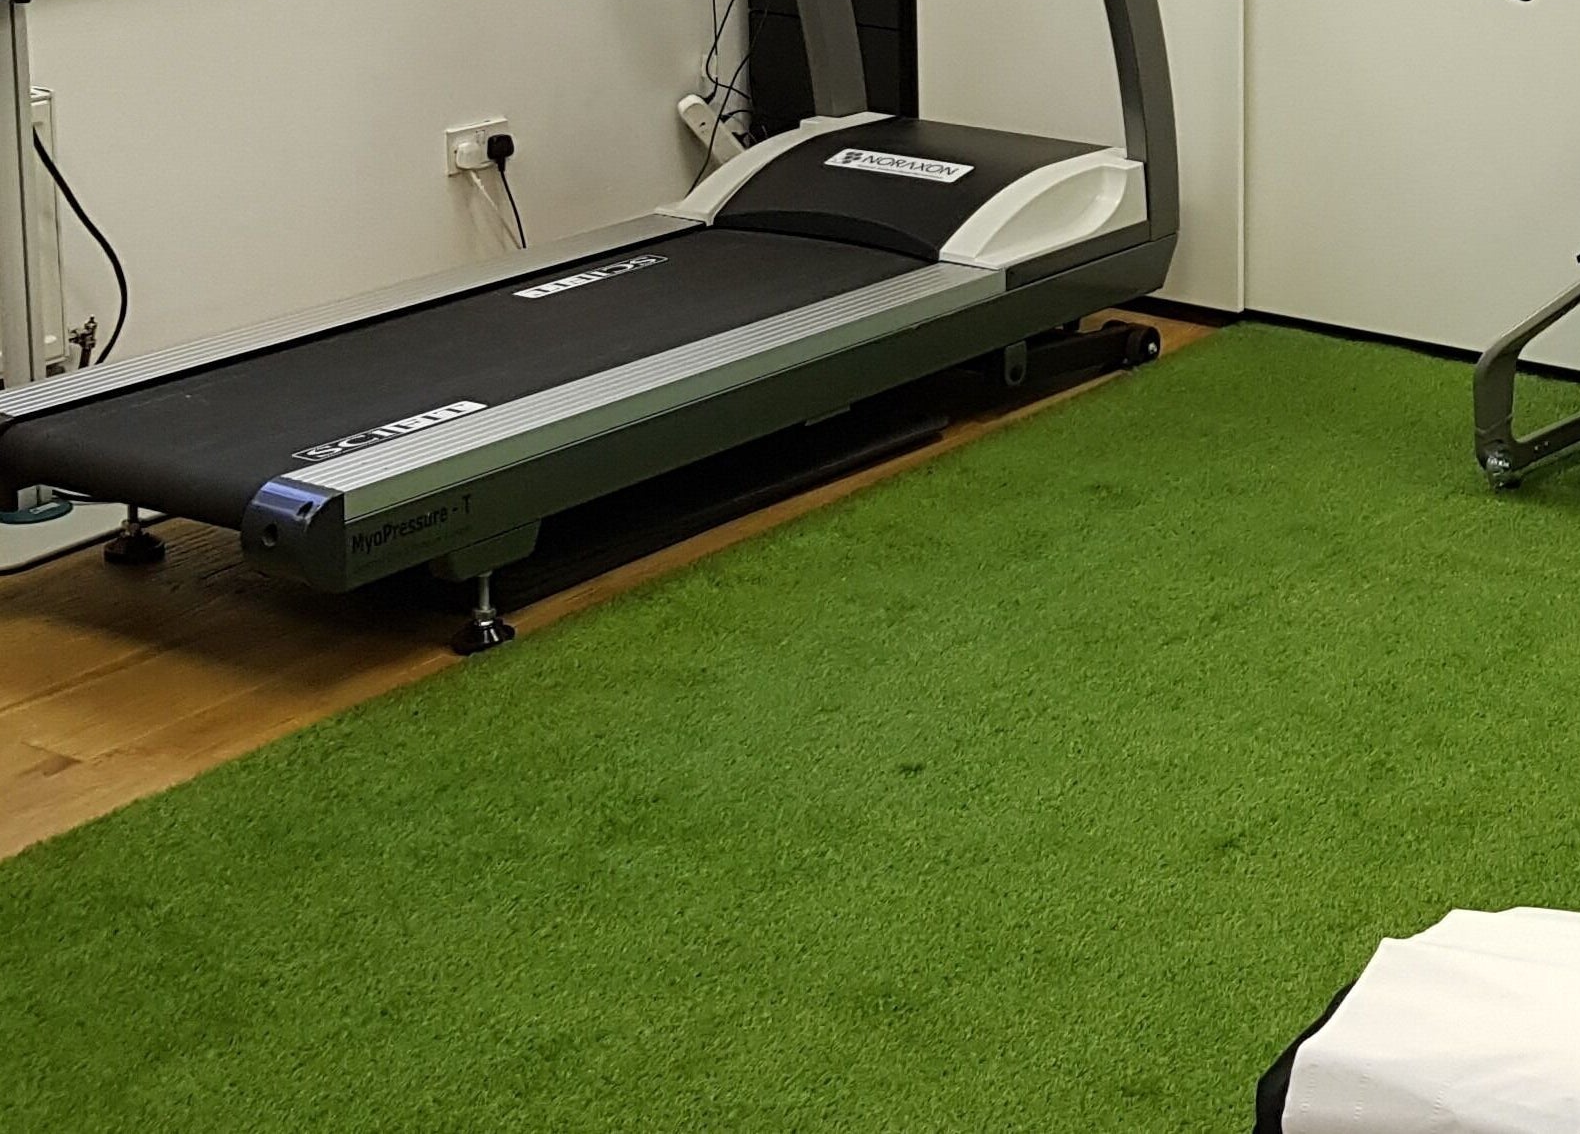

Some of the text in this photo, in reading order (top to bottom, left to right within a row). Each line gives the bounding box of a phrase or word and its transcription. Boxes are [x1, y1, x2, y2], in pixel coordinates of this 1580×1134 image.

[863, 155, 960, 176] NORAXON
[302, 402, 478, 460] SCIFIT
[352, 505, 449, 555] MyoPressure
[461, 493, 472, 515] T
